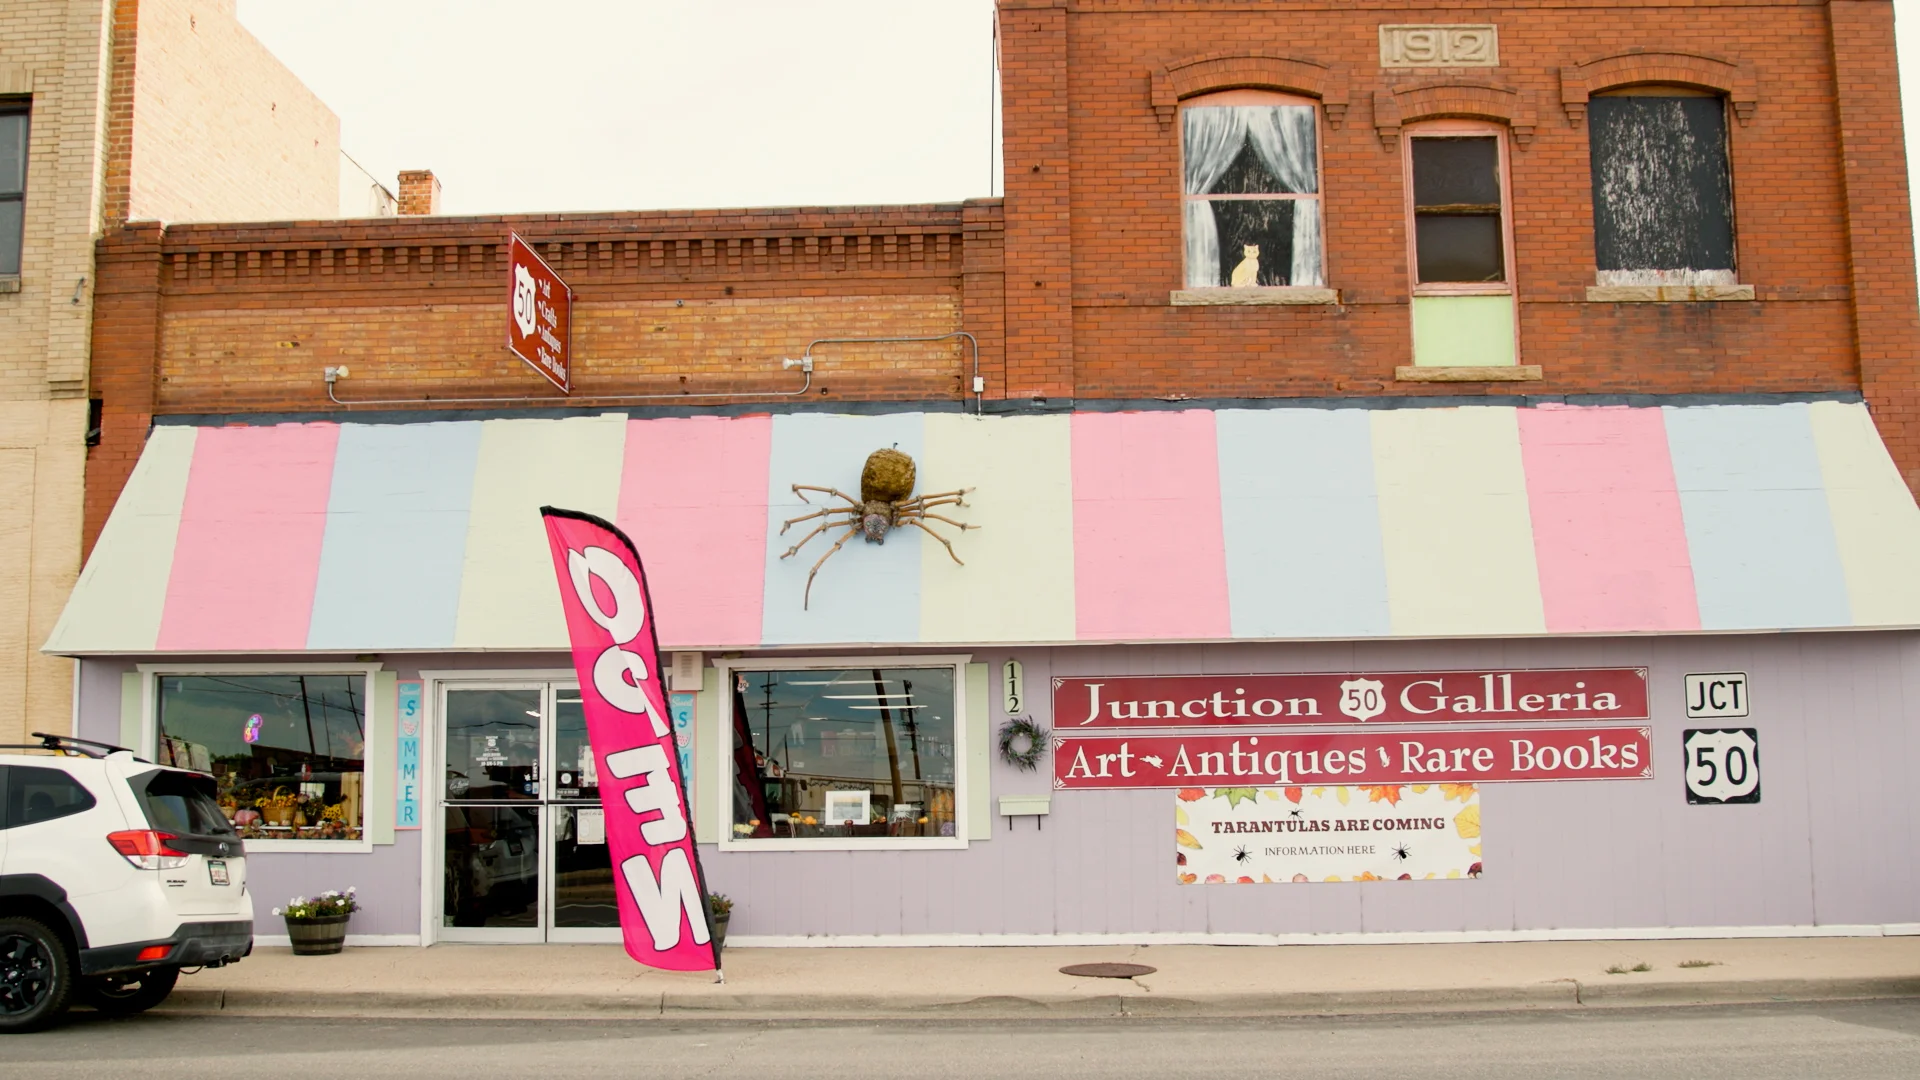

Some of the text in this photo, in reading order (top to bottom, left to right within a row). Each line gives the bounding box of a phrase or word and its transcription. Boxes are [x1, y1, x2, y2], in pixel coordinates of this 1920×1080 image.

[1392, 29, 1487, 62] 1912
[517, 281, 532, 325] 50
[542, 279, 550, 299] Art
[541, 301, 557, 328] Crafts
[541, 325, 561, 354] Antiques
[1007, 663, 1020, 713] 112
[1080, 673, 1622, 725] Junction 50 Galleria
[1690, 680, 1743, 711] JCT
[1065, 735, 1639, 784] Art Antiques Rare Books
[1696, 746, 1748, 787] 50
[1211, 817, 1446, 834] TARANTULAS ARE COMING
[1265, 845, 1376, 856] INFORMATION HERE
